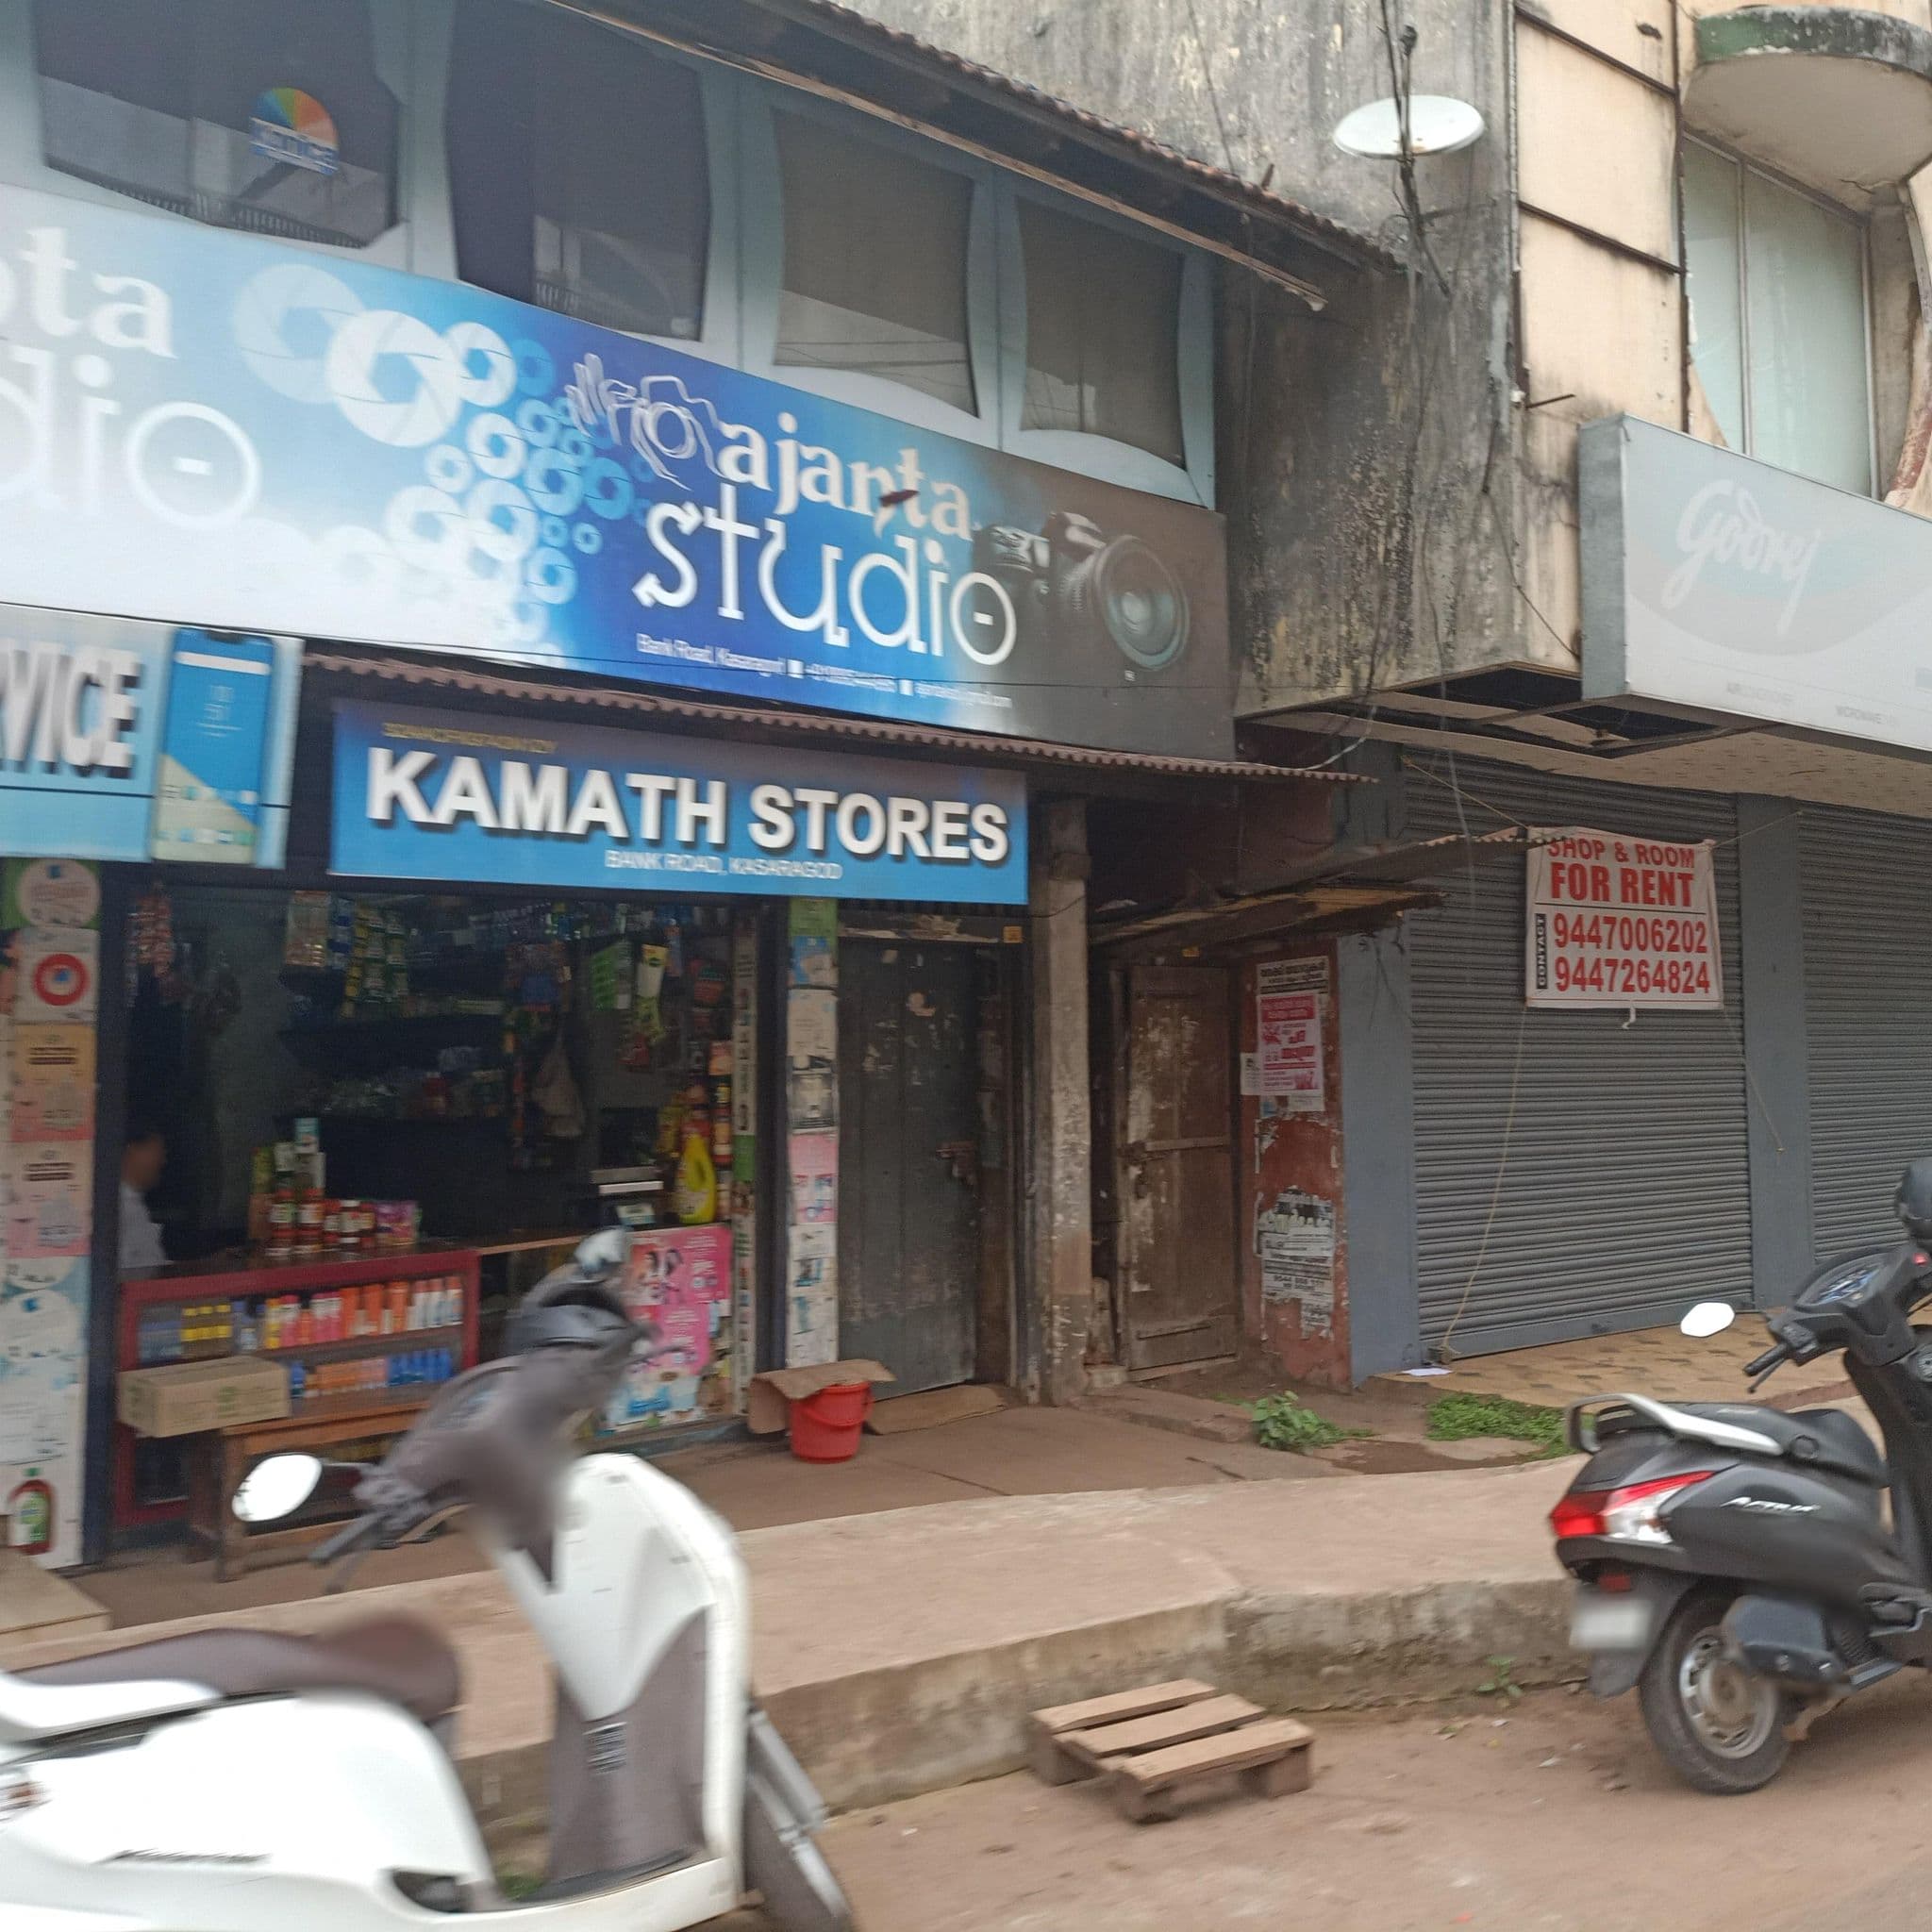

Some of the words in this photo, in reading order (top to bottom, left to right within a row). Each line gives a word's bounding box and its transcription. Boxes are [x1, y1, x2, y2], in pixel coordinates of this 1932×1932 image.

[718, 412, 974, 541] ajanta
[631, 484, 1018, 666] studio
[364, 745, 727, 845] KAMATH
[747, 782, 1009, 864] STORES
[1547, 838, 1606, 861] SHOP
[1614, 841, 1629, 862] &
[1637, 844, 1694, 868] ROOM
[1550, 862, 1611, 902] FOR
[1620, 868, 1694, 907] RENT
[1535, 913, 1548, 990] CONTACT
[1554, 913, 1707, 953] 9447006202
[1554, 956, 1710, 994] 9447264824
